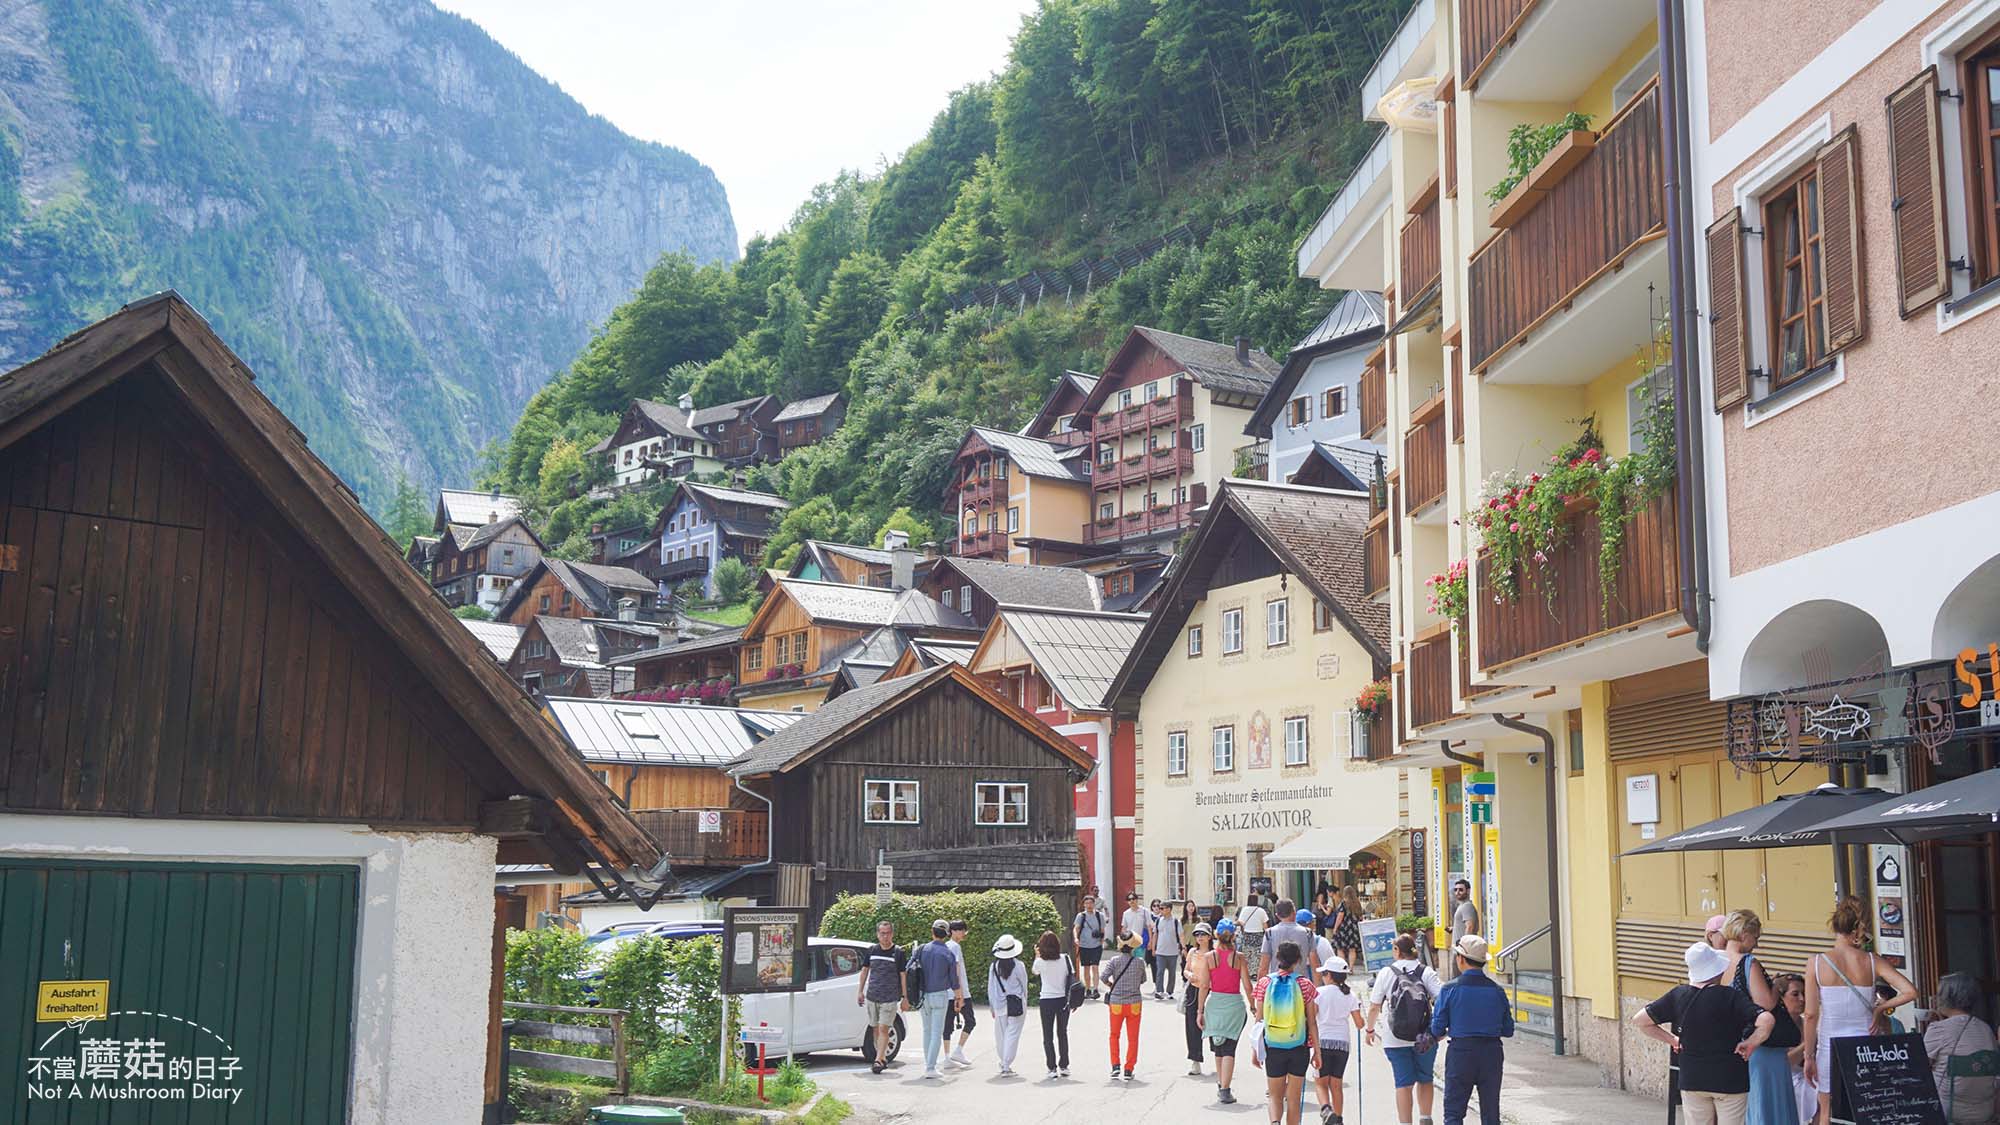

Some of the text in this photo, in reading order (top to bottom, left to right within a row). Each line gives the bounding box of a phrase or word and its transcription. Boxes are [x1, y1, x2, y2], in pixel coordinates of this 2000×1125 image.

[1195, 786, 1333, 806] Benediktiner Seifenmanufaktur
[1212, 808, 1312, 831] SALZKONTOR
[50, 988, 96, 998] Ausfahrt
[46, 1003, 99, 1013] freihalten!
